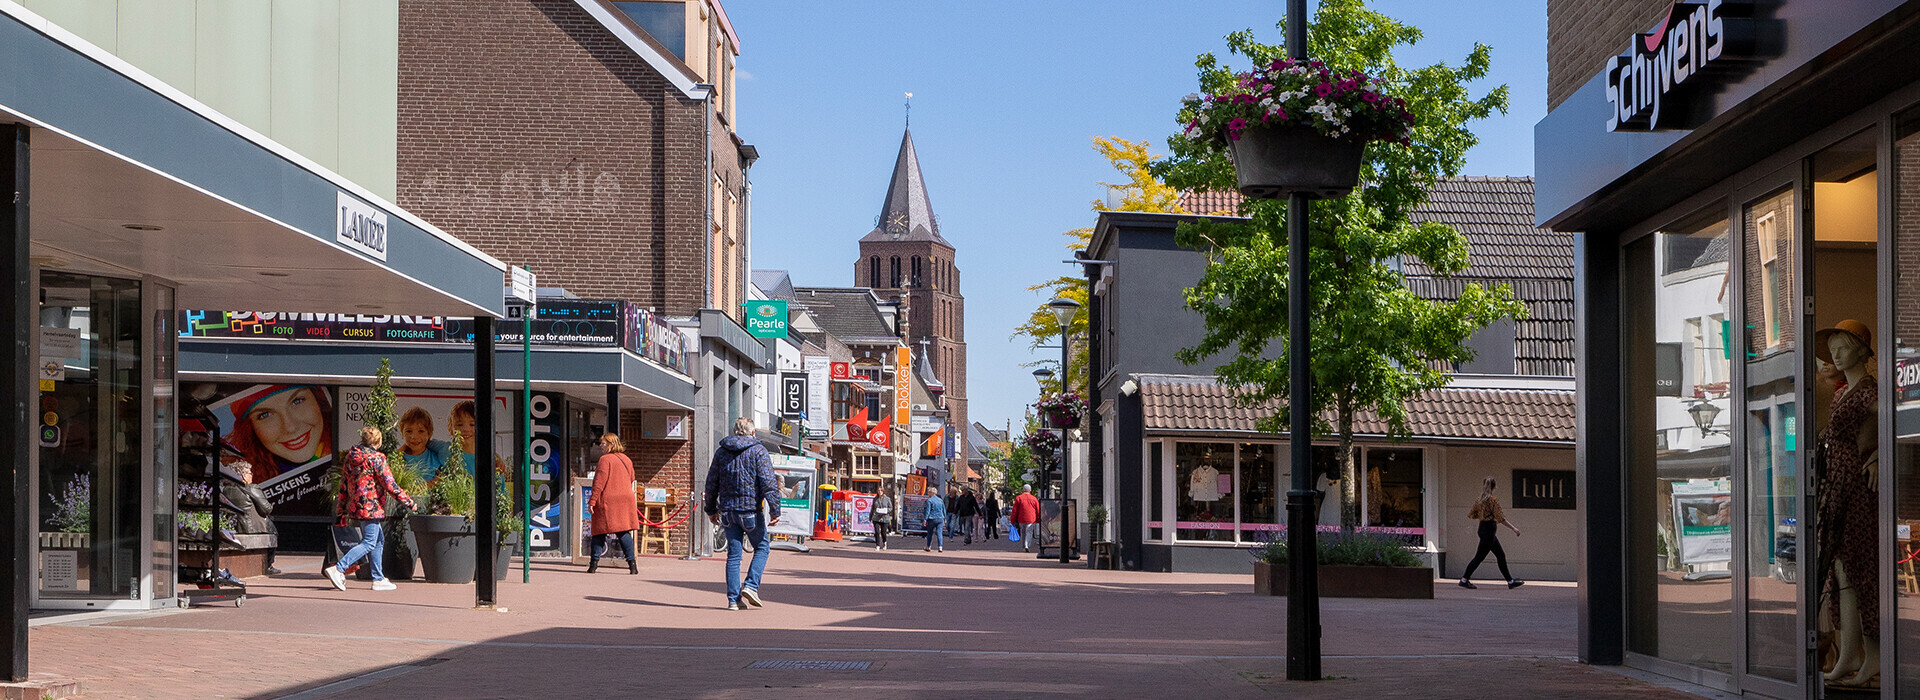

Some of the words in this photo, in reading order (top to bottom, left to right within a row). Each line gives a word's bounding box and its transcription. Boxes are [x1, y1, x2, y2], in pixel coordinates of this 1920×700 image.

[1605, 0, 1724, 133] Schijvens
[341, 205, 385, 254] LAMÉE
[749, 317, 785, 329] Pearle
[272, 326, 294, 335] FOTO
[306, 327, 330, 336] VIDEO
[342, 328, 374, 337] CURSUS
[386, 329, 435, 339] FOTOGRAFIE
[500, 333, 519, 341] your
[519, 333, 545, 341] surce
[558, 333, 614, 342] entertainment
[346, 392, 371, 402] POW
[788, 383, 800, 409] arts
[345, 402, 359, 412] TO
[530, 395, 551, 547] PASFOTO
[263, 473, 312, 499] ELSKENS
[1190, 522, 1220, 530] FASHION
